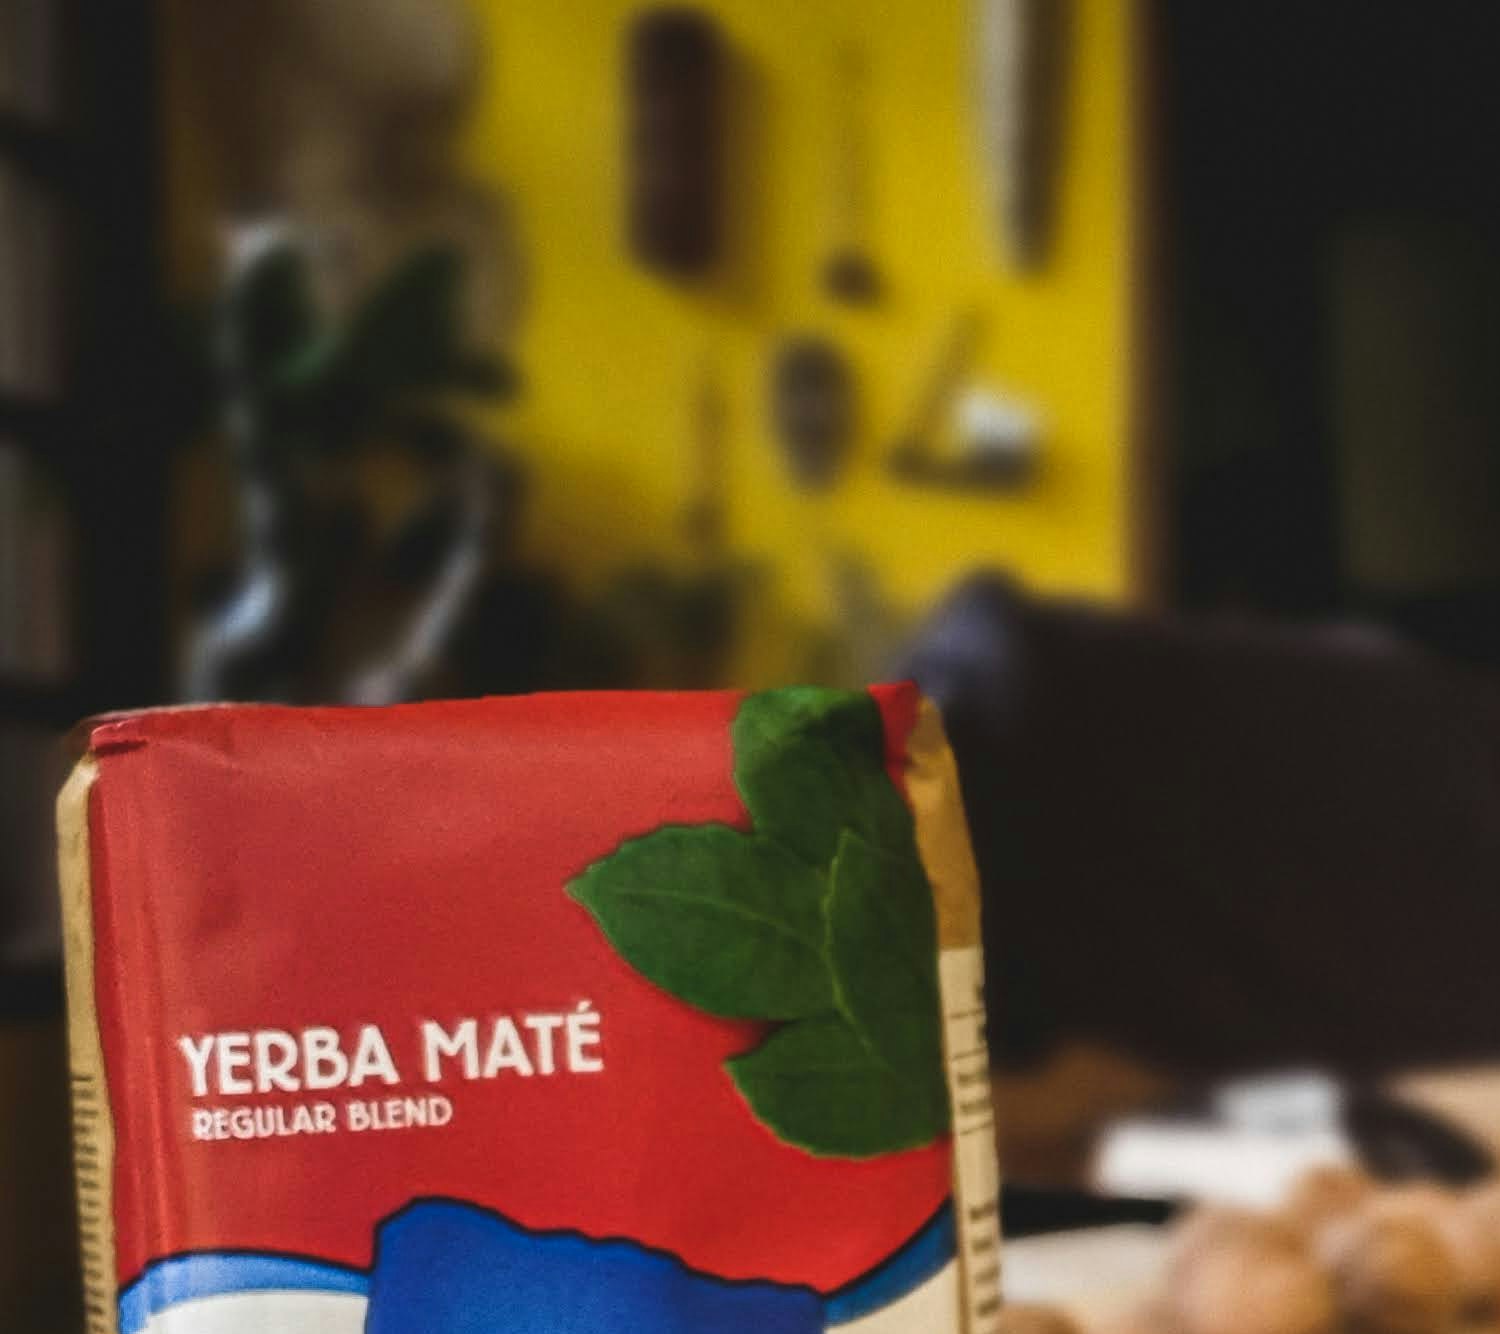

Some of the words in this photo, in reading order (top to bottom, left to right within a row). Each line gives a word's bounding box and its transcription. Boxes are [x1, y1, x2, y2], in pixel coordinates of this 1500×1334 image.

[180, 1022, 400, 1097] YERBA
[421, 1000, 604, 1083] MATÉ
[192, 1104, 338, 1141] REGULAR
[346, 1095, 453, 1132] BLEND
